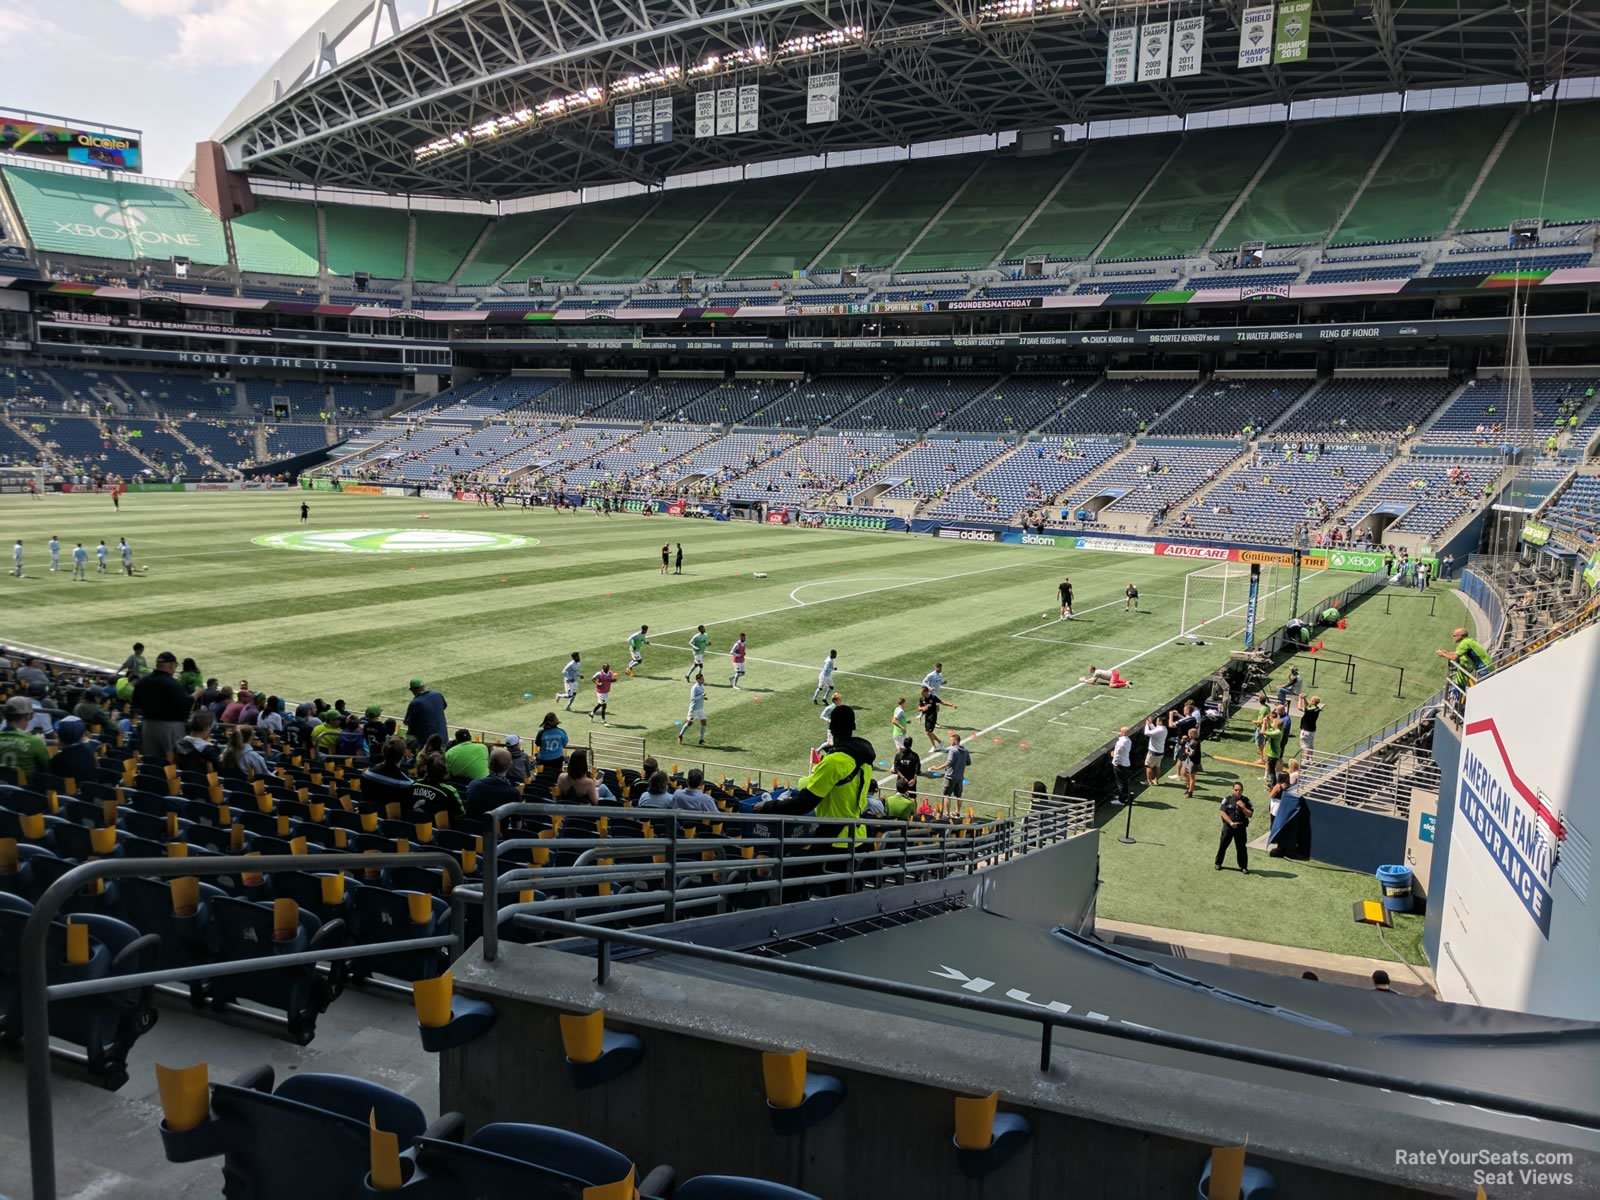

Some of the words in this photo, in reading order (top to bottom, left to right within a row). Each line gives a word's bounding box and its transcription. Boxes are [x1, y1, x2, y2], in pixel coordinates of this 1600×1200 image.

[1280, 5, 1294, 14] MLS
[1296, 3, 1310, 11] CUP
[1244, 14, 1271, 24] SHIELD
[1143, 28, 1168, 37] CHAMPS
[1176, 23, 1201, 32] CHAMPS
[1278, 40, 1306, 50] CHAMPS
[1240, 47, 1270, 57] CHAMPS
[1281, 49, 1301, 58] 2016
[1179, 56, 1194, 64] 2011
[1246, 55, 1263, 64] 2014
[1145, 61, 1161, 69] 2009
[1178, 64, 1194, 72] 2014
[1145, 68, 1161, 76] 2010
[809, 80, 838, 89] CHAMPIONS
[720, 99, 733, 107] 2013
[742, 96, 755, 104] 2014
[53, 220, 134, 241] XBOX
[141, 231, 201, 246] ONE
[1242, 285, 1278, 297] SOUNDERS
[1279, 287, 1288, 296] FC
[884, 303, 910, 312] SPORTING
[911, 302, 919, 311] KC
[948, 299, 1032, 309] #SOUNDERSMATCHDAY
[801, 305, 827, 314] SOUNDERS
[827, 305, 835, 313] FC
[53, 311, 69, 320] THE
[71, 312, 89, 321] PRO
[90, 313, 113, 323] SHOP
[127, 319, 161, 329] SEATTLE
[162, 321, 204, 332] SEAHAWKS
[204, 324, 220, 333] AND
[221, 325, 260, 336] SOUNDERS
[261, 328, 273, 336] FC
[1149, 335, 1159, 343] 96
[1159, 335, 1181, 343] CORTEZ
[1181, 334, 1207, 342] KENNEDY
[1237, 332, 1246, 341] 71
[1246, 332, 1269, 341] WALTER
[1269, 331, 1289, 340] JONES
[1320, 329, 1339, 339] RING
[1340, 329, 1351, 338] OF
[1352, 328, 1380, 338] HONOR
[963, 338, 978, 346] KENNY
[978, 338, 995, 346] EASLEY
[1027, 337, 1039, 345] DAVE
[1040, 337, 1056, 345] KRIEG
[1090, 336, 1107, 344] CHUCK
[1107, 335, 1123, 343] KNOX
[179, 352, 229, 364] HOME
[239, 355, 260, 365] OF
[271, 357, 302, 368] THE
[313, 360, 337, 370] 12s
[960, 530, 995, 541] adidas
[1021, 534, 1055, 546] slalom
[1166, 545, 1229, 559] ADVOCARE
[1305, 558, 1326, 567] TIRE
[1345, 554, 1377, 567] XBOX
[545, 740, 559, 751] 10
[1462, 747, 1510, 829] AMERICAN
[413, 787, 436, 800] ALONSO
[753, 828, 771, 838] LIGHT
[1511, 805, 1554, 889] FAMILY
[1464, 791, 1543, 919] INSURANCE
